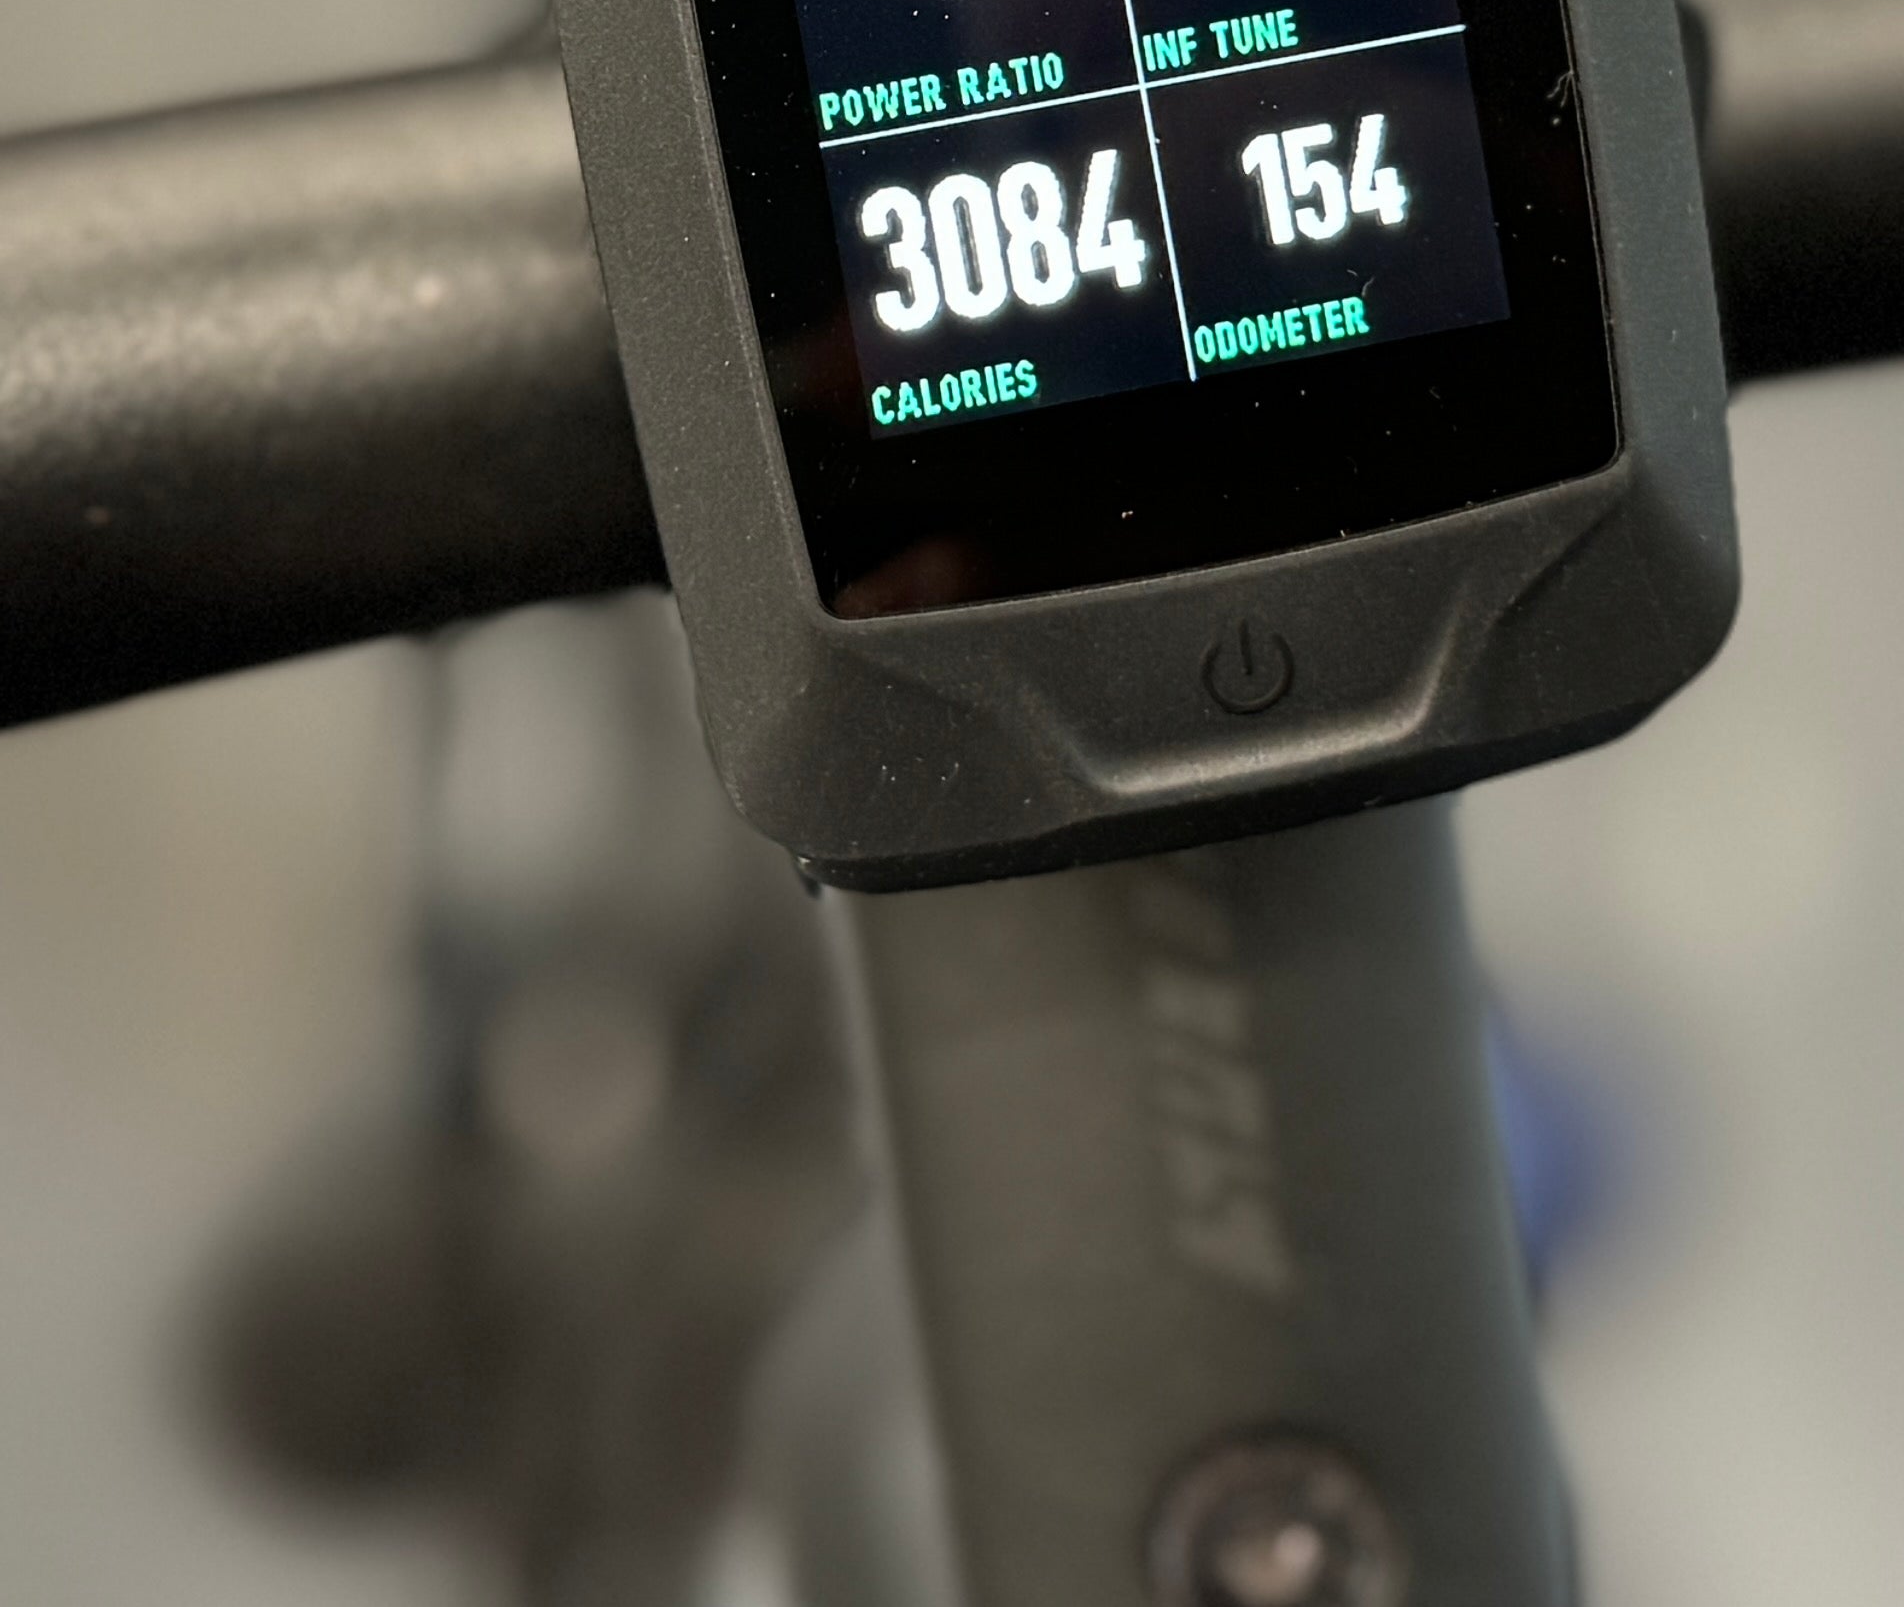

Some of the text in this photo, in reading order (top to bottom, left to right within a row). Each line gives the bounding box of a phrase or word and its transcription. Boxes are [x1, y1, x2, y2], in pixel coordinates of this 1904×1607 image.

[1143, 9, 1298, 74] INF TUNE
[819, 53, 1065, 131] POWER RATIO
[1242, 114, 1408, 245] 154
[862, 150, 1147, 334] 3084
[1194, 298, 1369, 362] ODOMETER
[872, 361, 1037, 424] CALORIES
